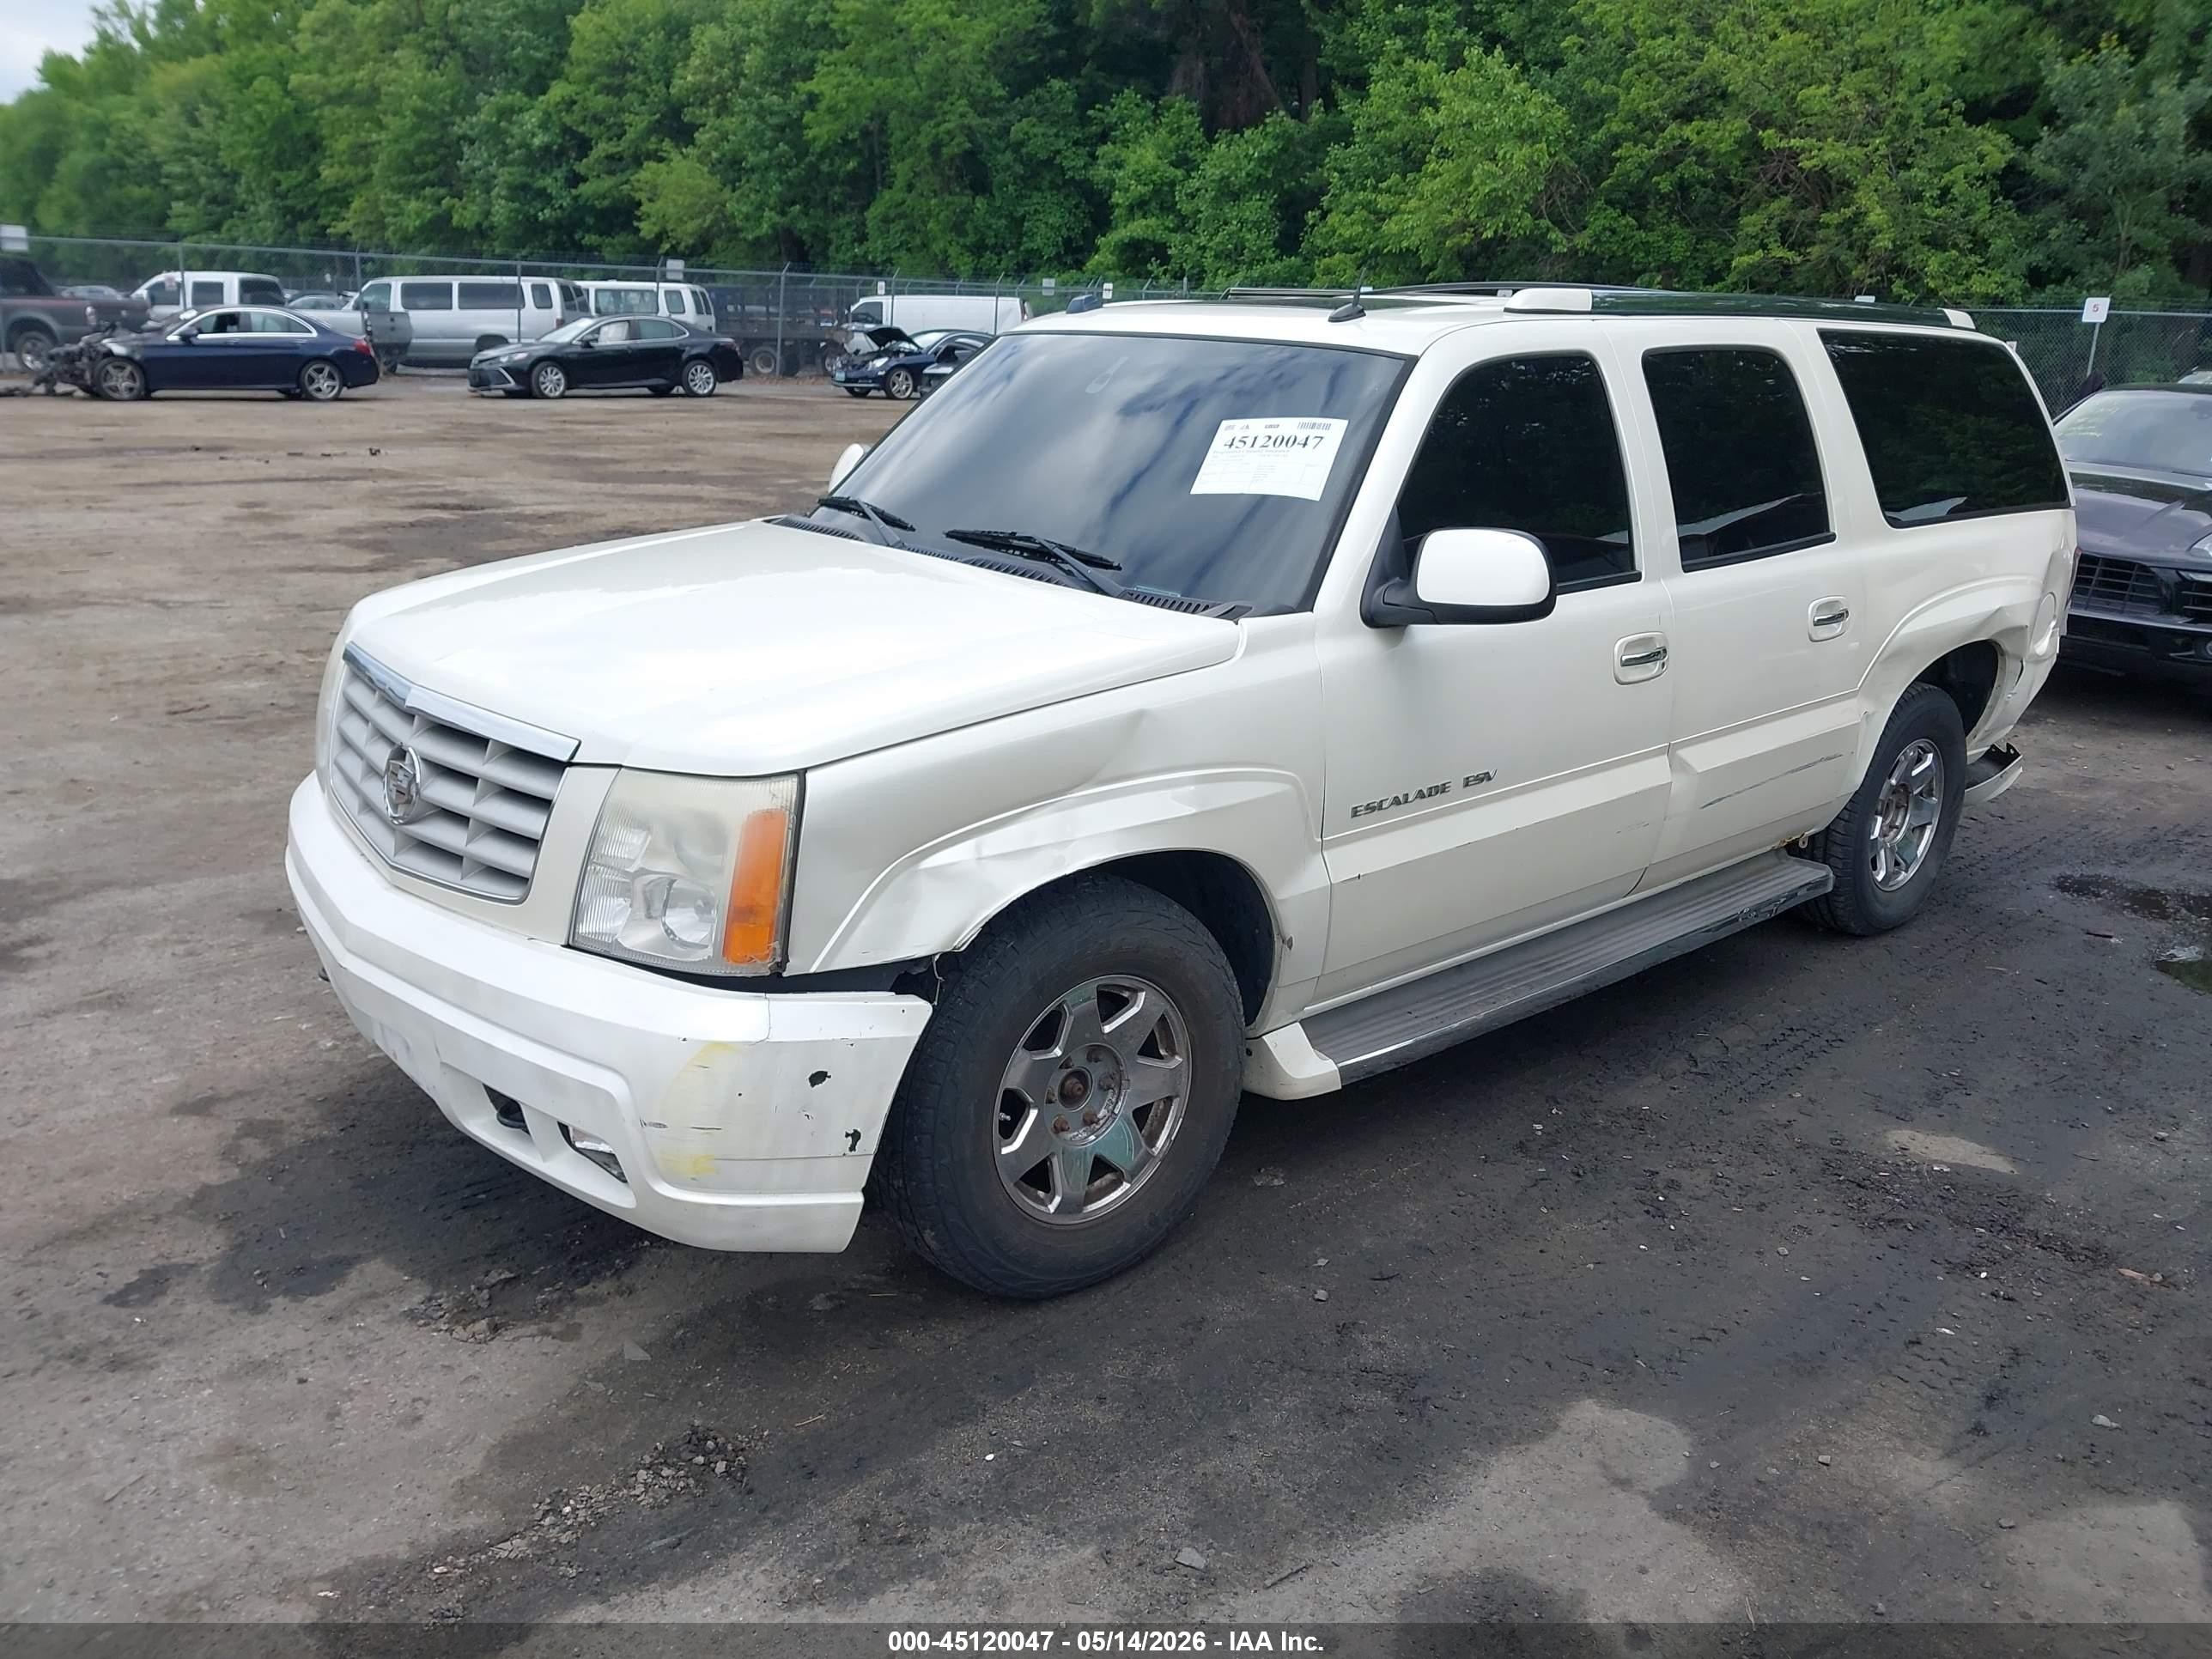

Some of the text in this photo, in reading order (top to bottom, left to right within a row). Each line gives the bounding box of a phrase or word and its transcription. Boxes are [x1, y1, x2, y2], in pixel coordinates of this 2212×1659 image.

[2092, 303, 2100, 313] 5
[1224, 434, 1325, 450] 45120047
[1351, 769, 1498, 818] ESCALADE ESV
